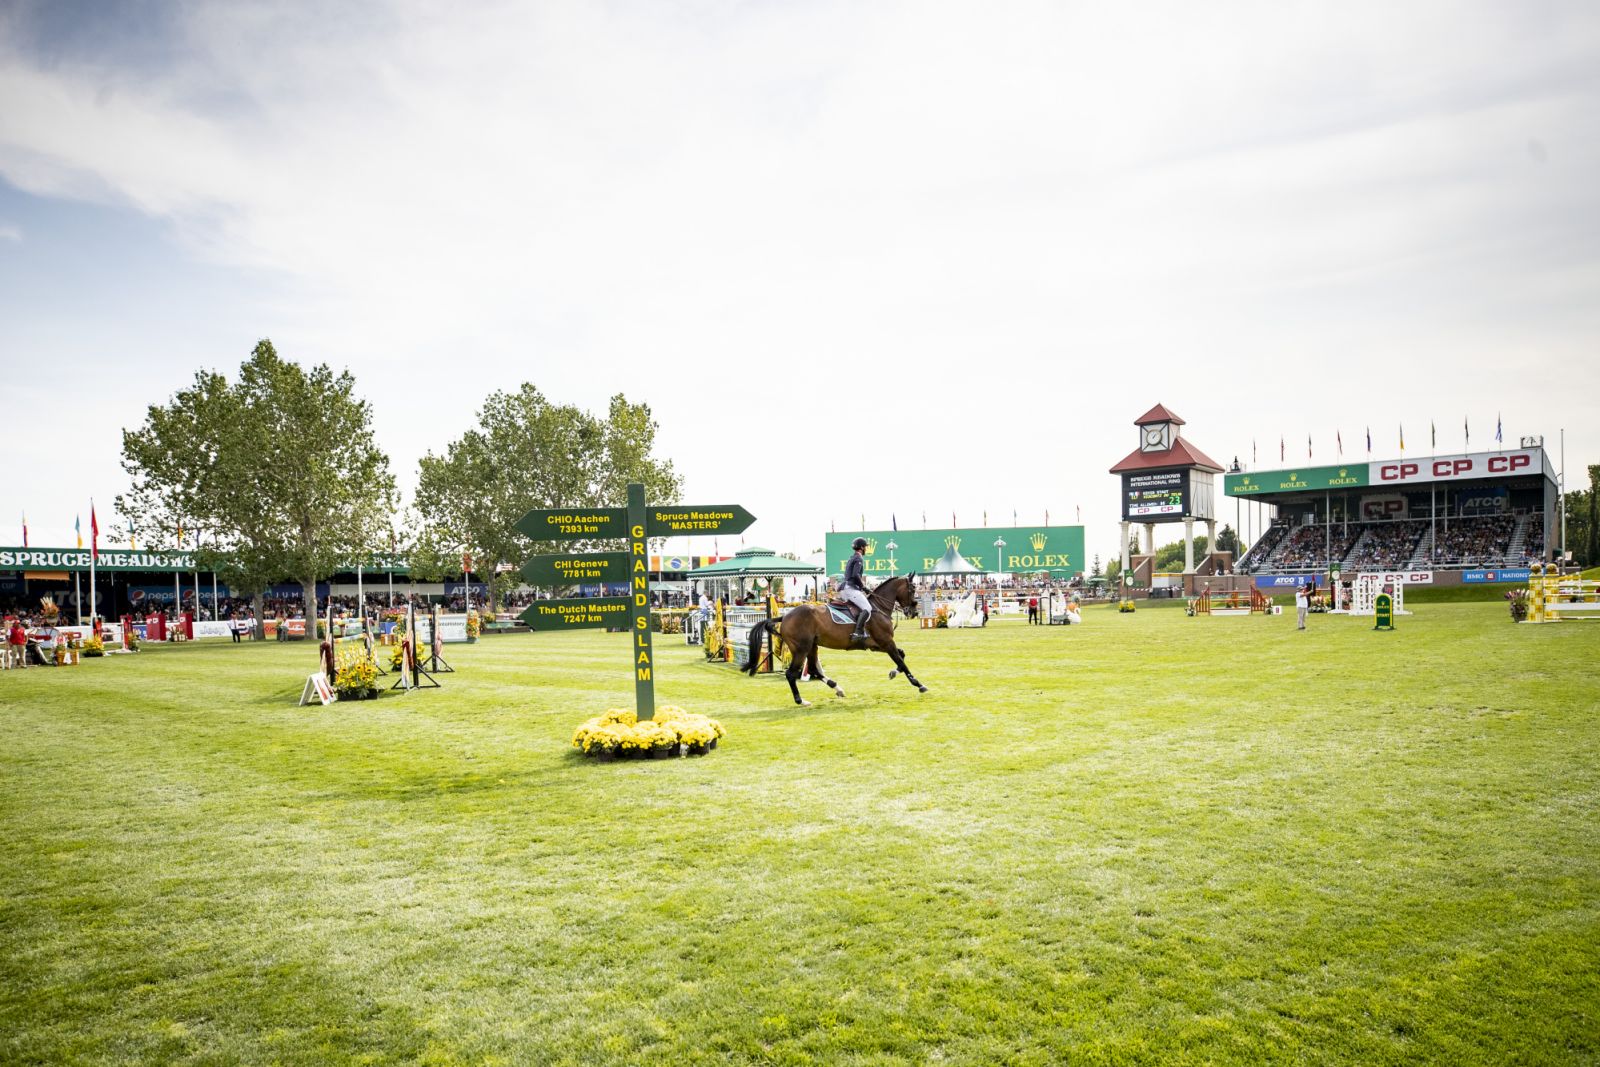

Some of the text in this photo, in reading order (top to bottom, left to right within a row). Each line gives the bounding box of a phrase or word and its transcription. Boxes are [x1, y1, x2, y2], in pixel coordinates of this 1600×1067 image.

[1433, 459, 1472, 477] CP
[1488, 454, 1530, 473] CP
[1381, 464, 1418, 481] CP
[1280, 481, 1307, 489] ROLEX
[1329, 477, 1358, 485] ROLEX
[1234, 485, 1259, 493] ROLEX
[1169, 496, 1180, 505] 23
[1464, 496, 1502, 508] ATCO
[1363, 500, 1403, 517] CP
[547, 515, 610, 524] CHIO Aachen
[655, 511, 734, 522] Spruce Meadows
[559, 525, 599, 533] 7393 km
[0, 552, 196, 568] SPRUCE MEADOWS
[573, 560, 608, 568] Geneva
[840, 559, 900, 571] RLEX
[1008, 554, 1070, 568] ROLEX
[631, 525, 648, 607] GRAND
[563, 569, 601, 578] 7781 km
[1410, 573, 1429, 582] CP
[452, 586, 480, 595] ATCO
[147, 591, 177, 601] pepsi
[538, 604, 626, 614] The Dutch Masters
[564, 614, 602, 623] 7247 km
[636, 616, 651, 681] SLAM
